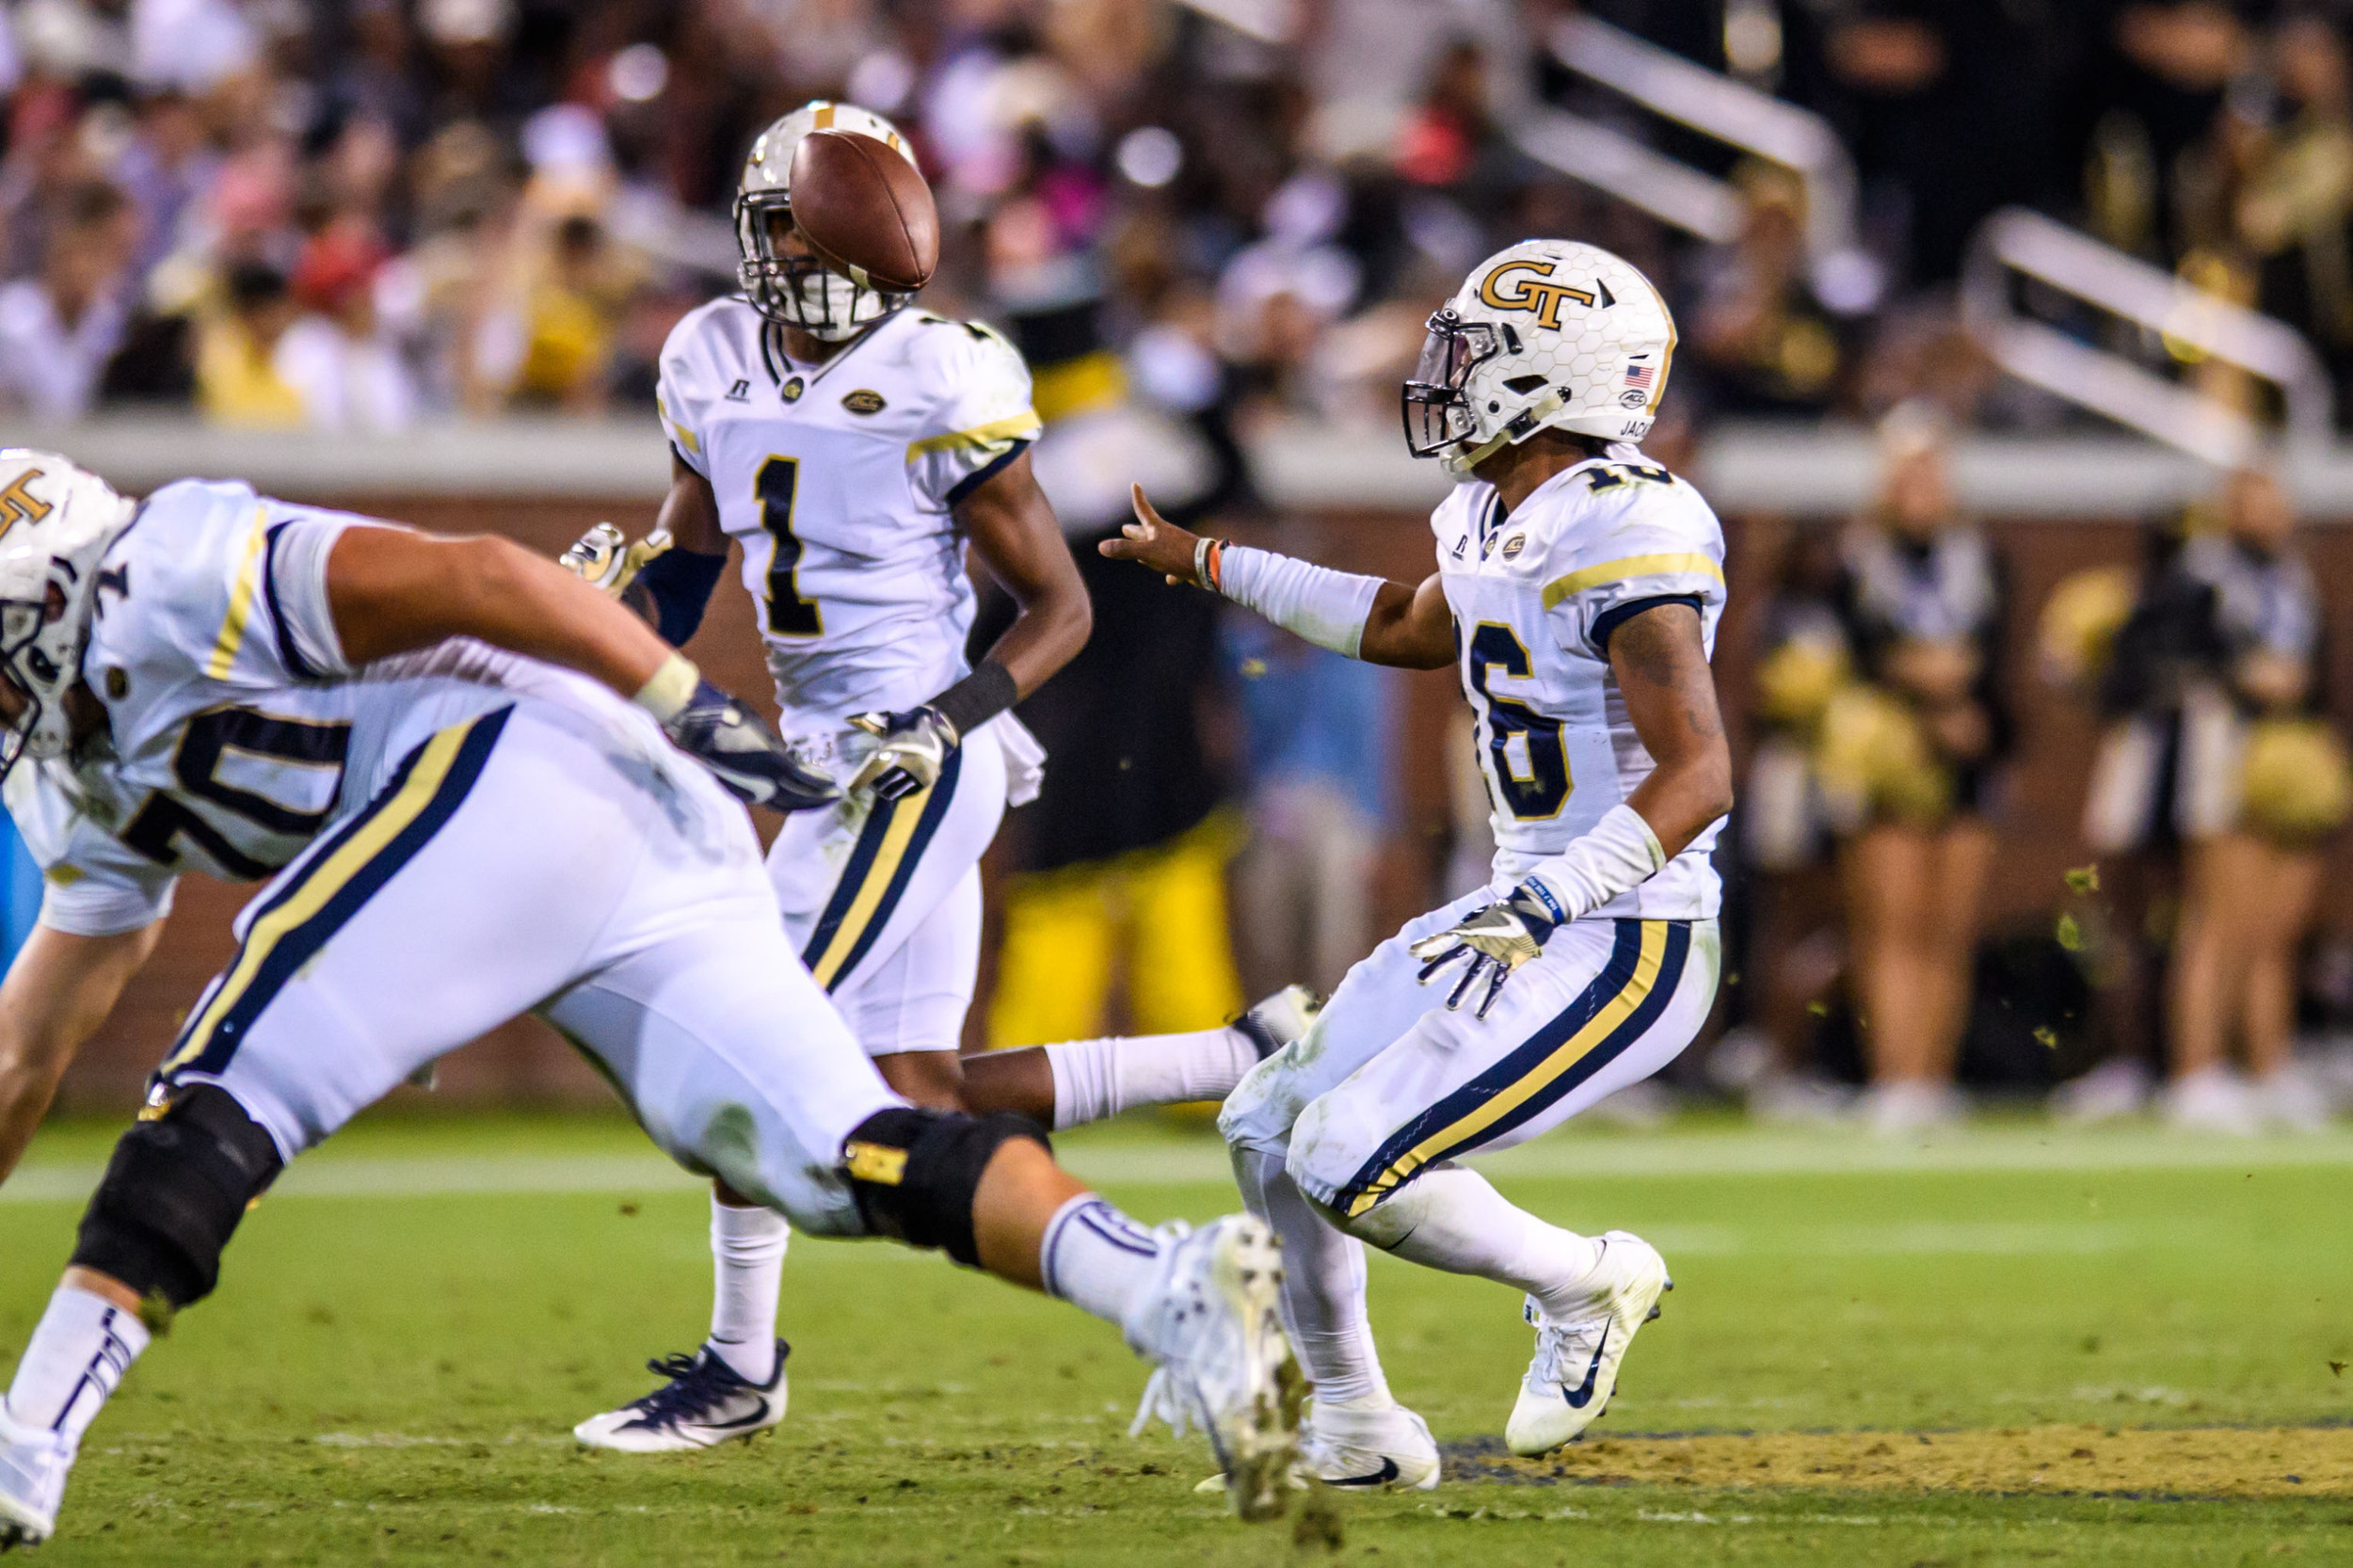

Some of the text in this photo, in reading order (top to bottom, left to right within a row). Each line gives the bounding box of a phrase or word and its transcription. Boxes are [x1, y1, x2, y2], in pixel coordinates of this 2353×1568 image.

[1481, 260, 1596, 332] GT
[0, 468, 54, 541] T
[753, 453, 825, 638] 1
[120, 699, 355, 881] 70
[1451, 614, 1576, 822] 6
